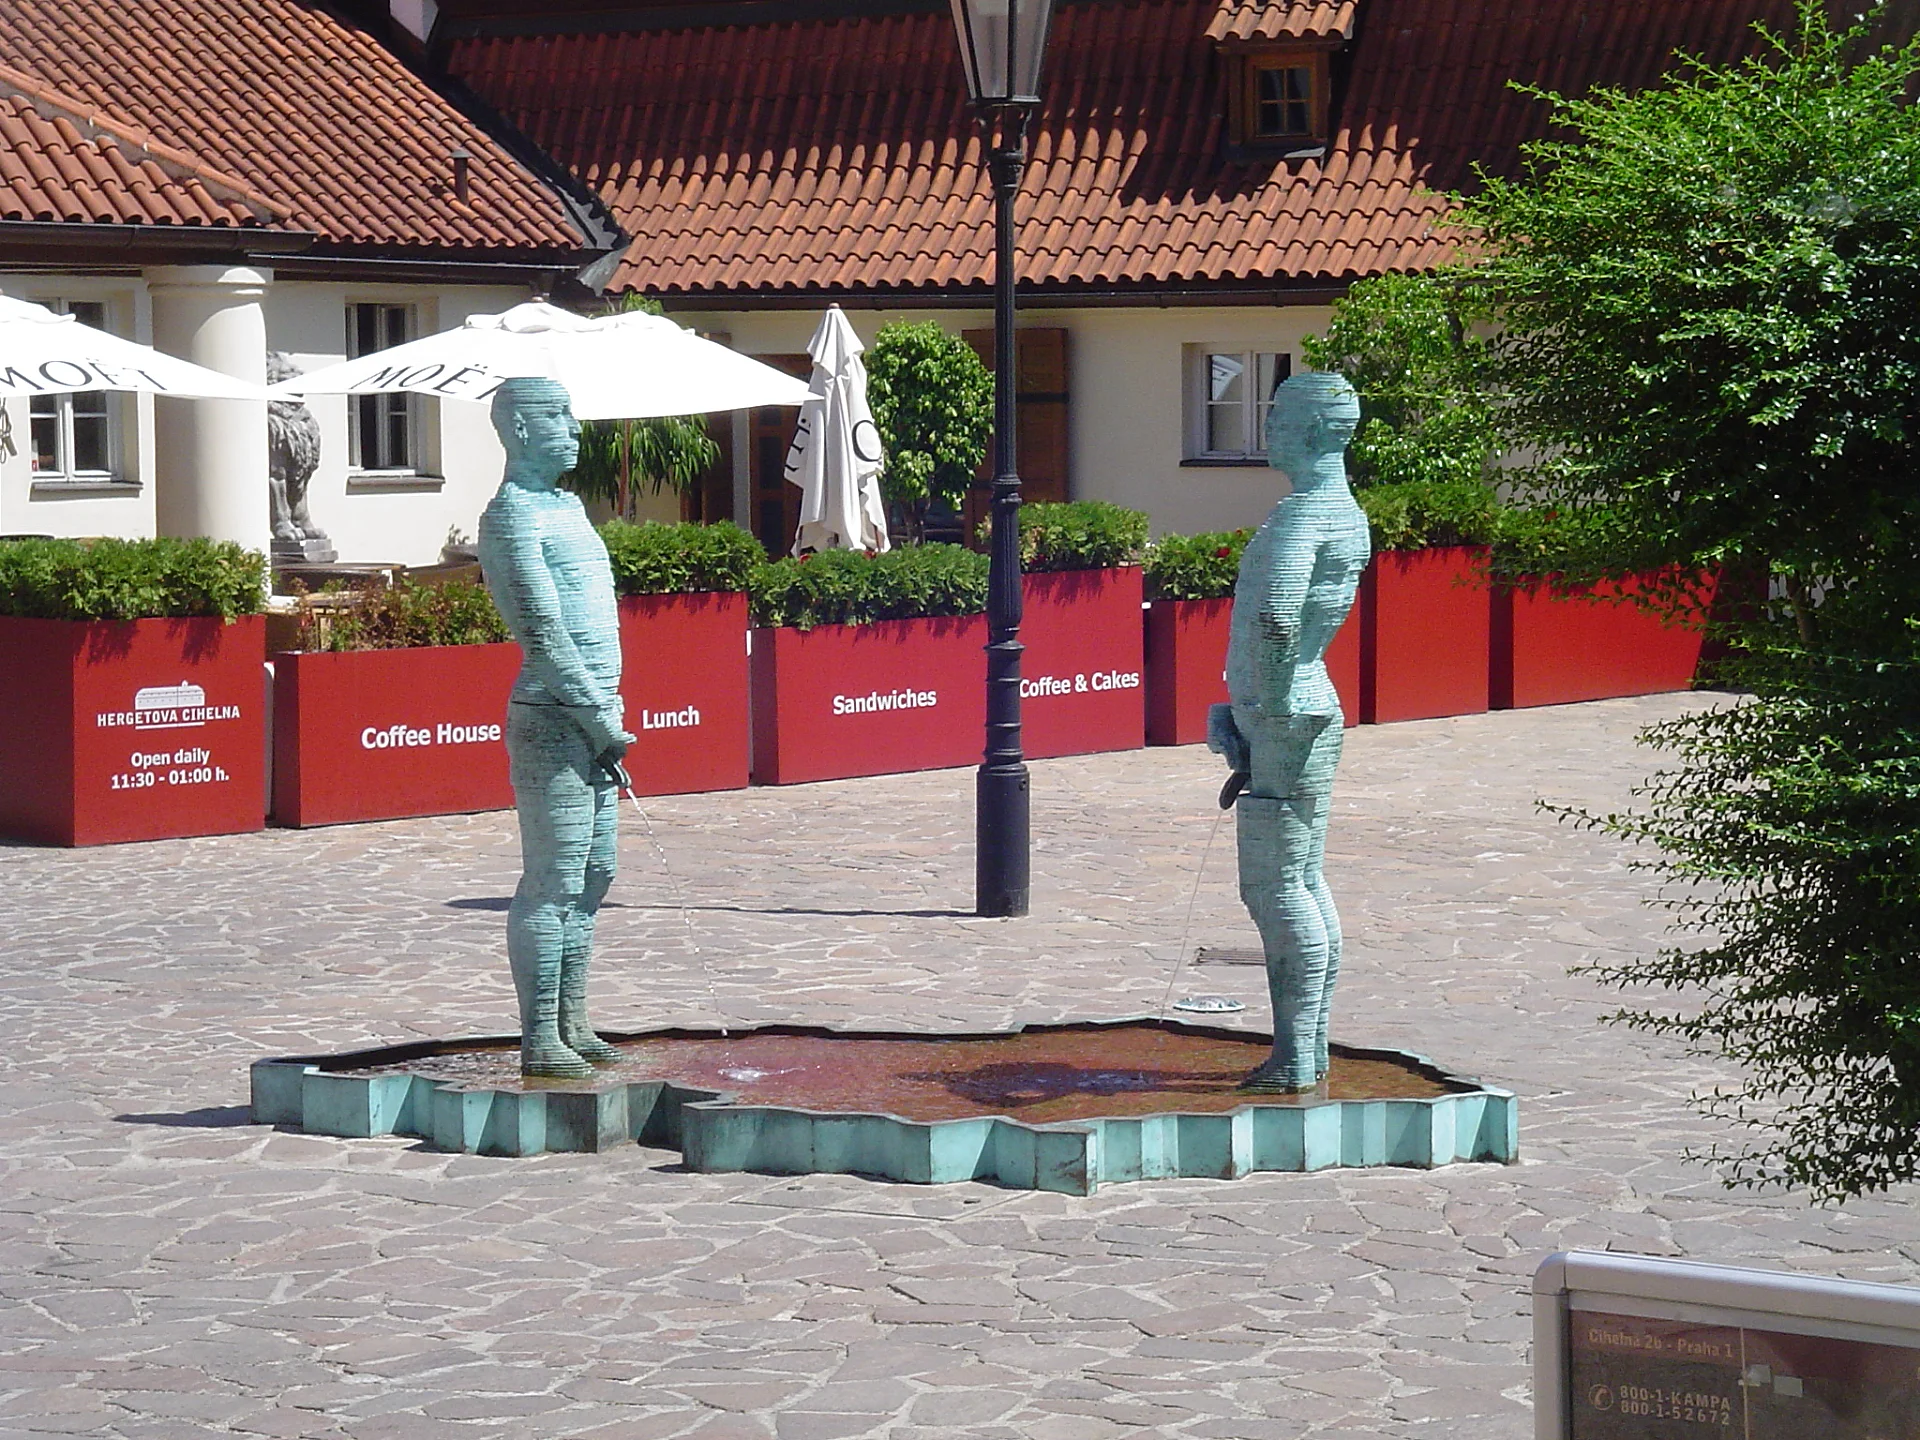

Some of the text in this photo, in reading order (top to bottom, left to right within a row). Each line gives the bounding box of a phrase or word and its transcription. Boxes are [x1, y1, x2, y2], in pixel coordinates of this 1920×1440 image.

[1019, 670, 1140, 698] Coffee & Cakes
[833, 689, 937, 715] Sandwiches
[97, 705, 241, 727] HERGETOVA CIHELNA
[642, 705, 700, 730] Lunch
[361, 723, 501, 749] Coffee House
[131, 748, 210, 769] Open daily
[111, 772, 155, 789] 11:30
[169, 768, 212, 785] 01:00
[215, 767, 230, 780] h.
[1677, 1338, 1720, 1357] Praha
[1725, 1343, 1733, 1358] 1
[1620, 1385, 1731, 1411] 800-1-KAMPA
[1621, 1400, 1729, 1425] 800-1-52672
